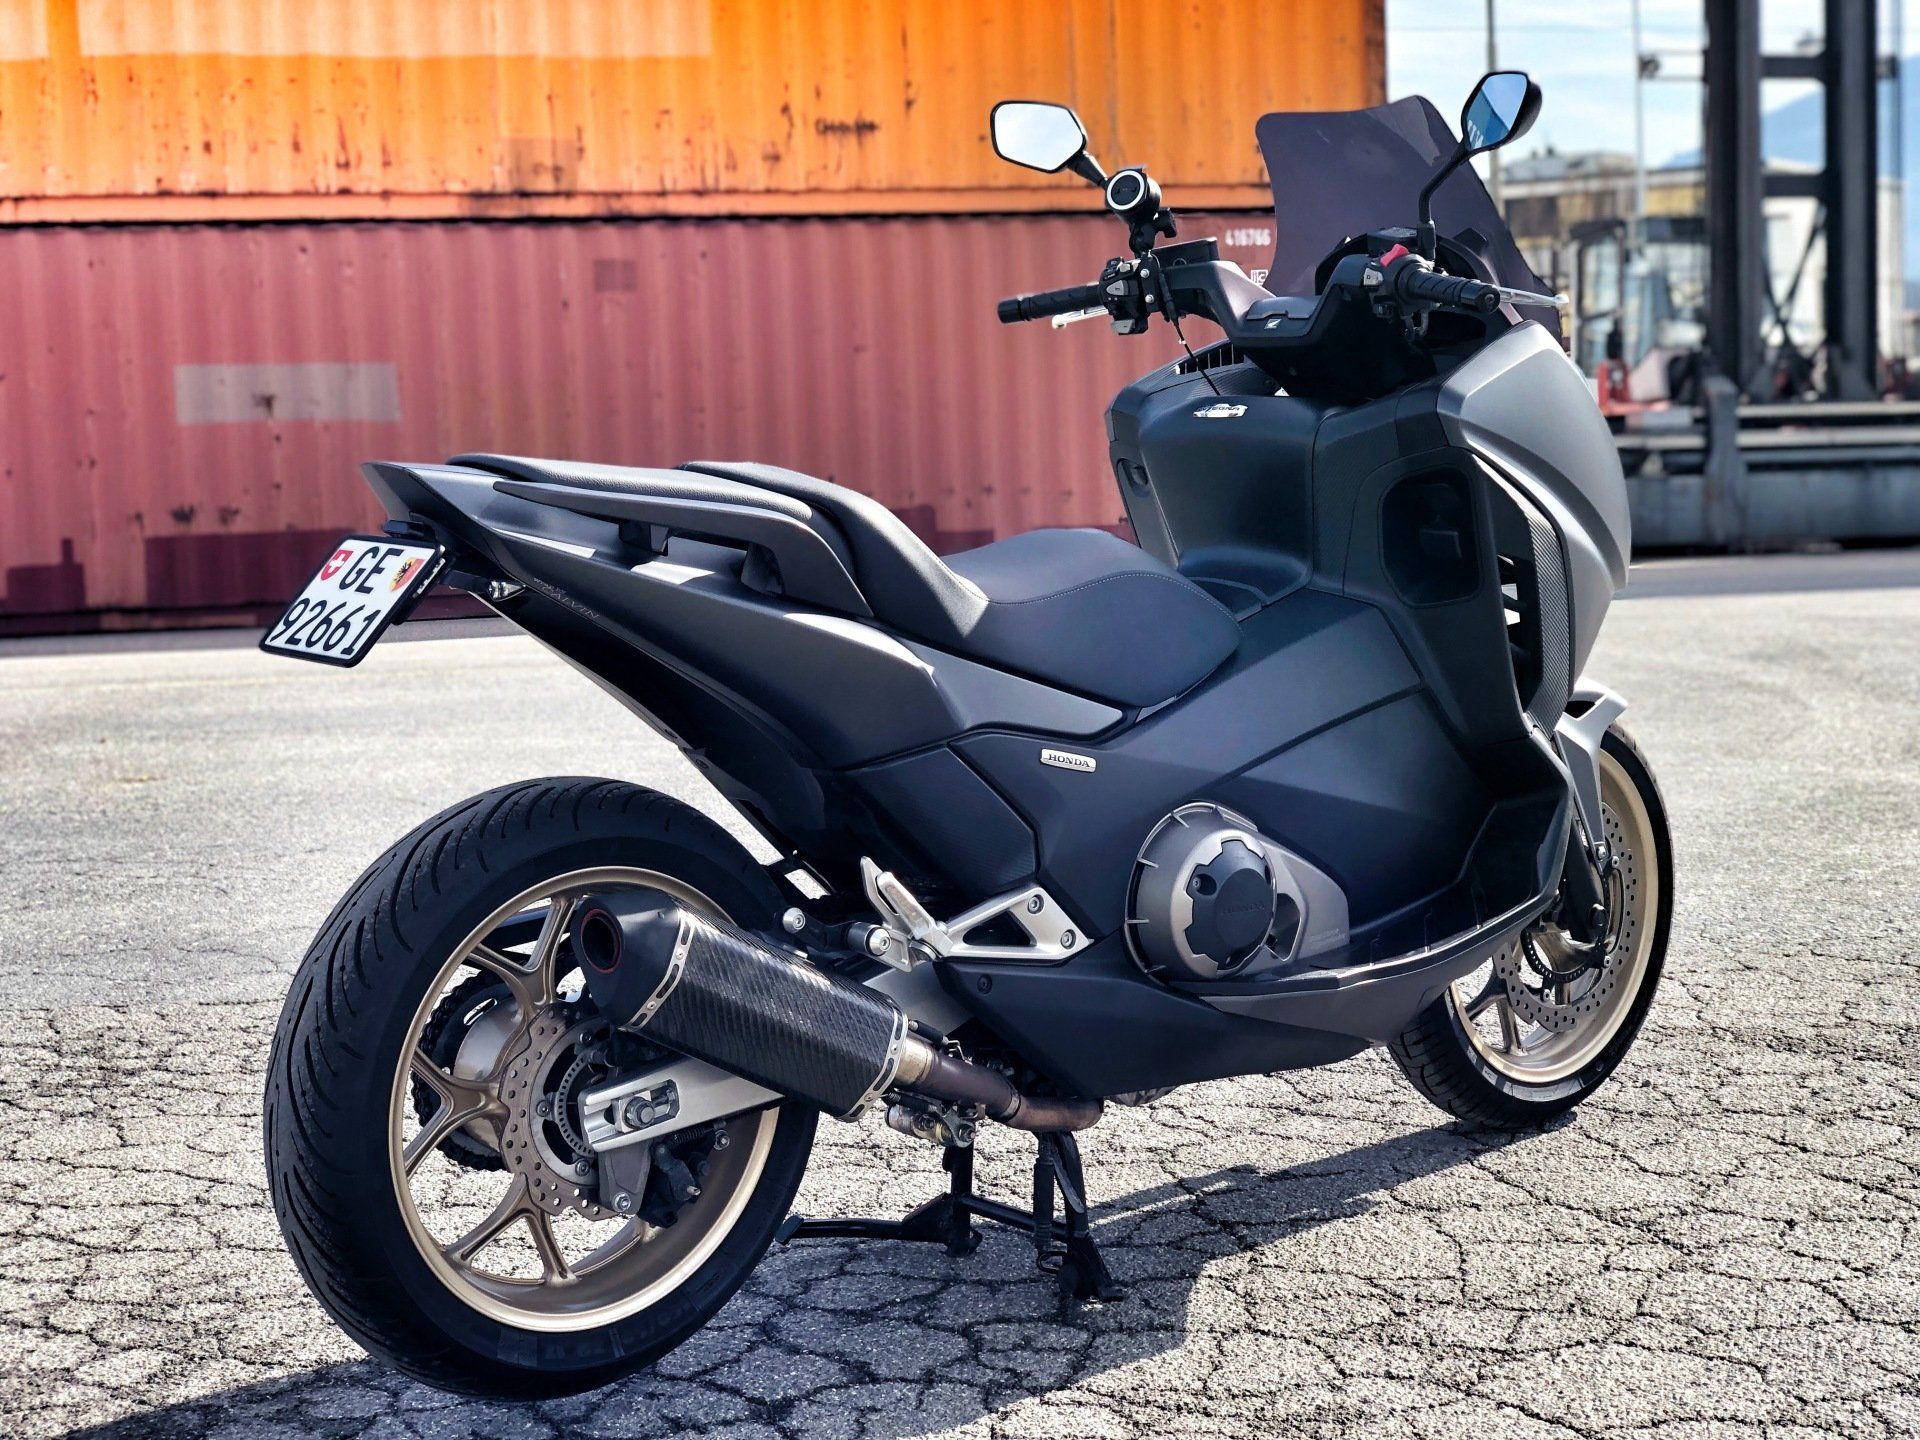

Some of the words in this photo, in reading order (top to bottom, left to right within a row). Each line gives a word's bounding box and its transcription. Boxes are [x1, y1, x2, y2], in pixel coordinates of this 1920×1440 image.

[338, 546, 404, 594] GE
[269, 597, 381, 655] 92661
[1048, 752, 1090, 768] HONDA
